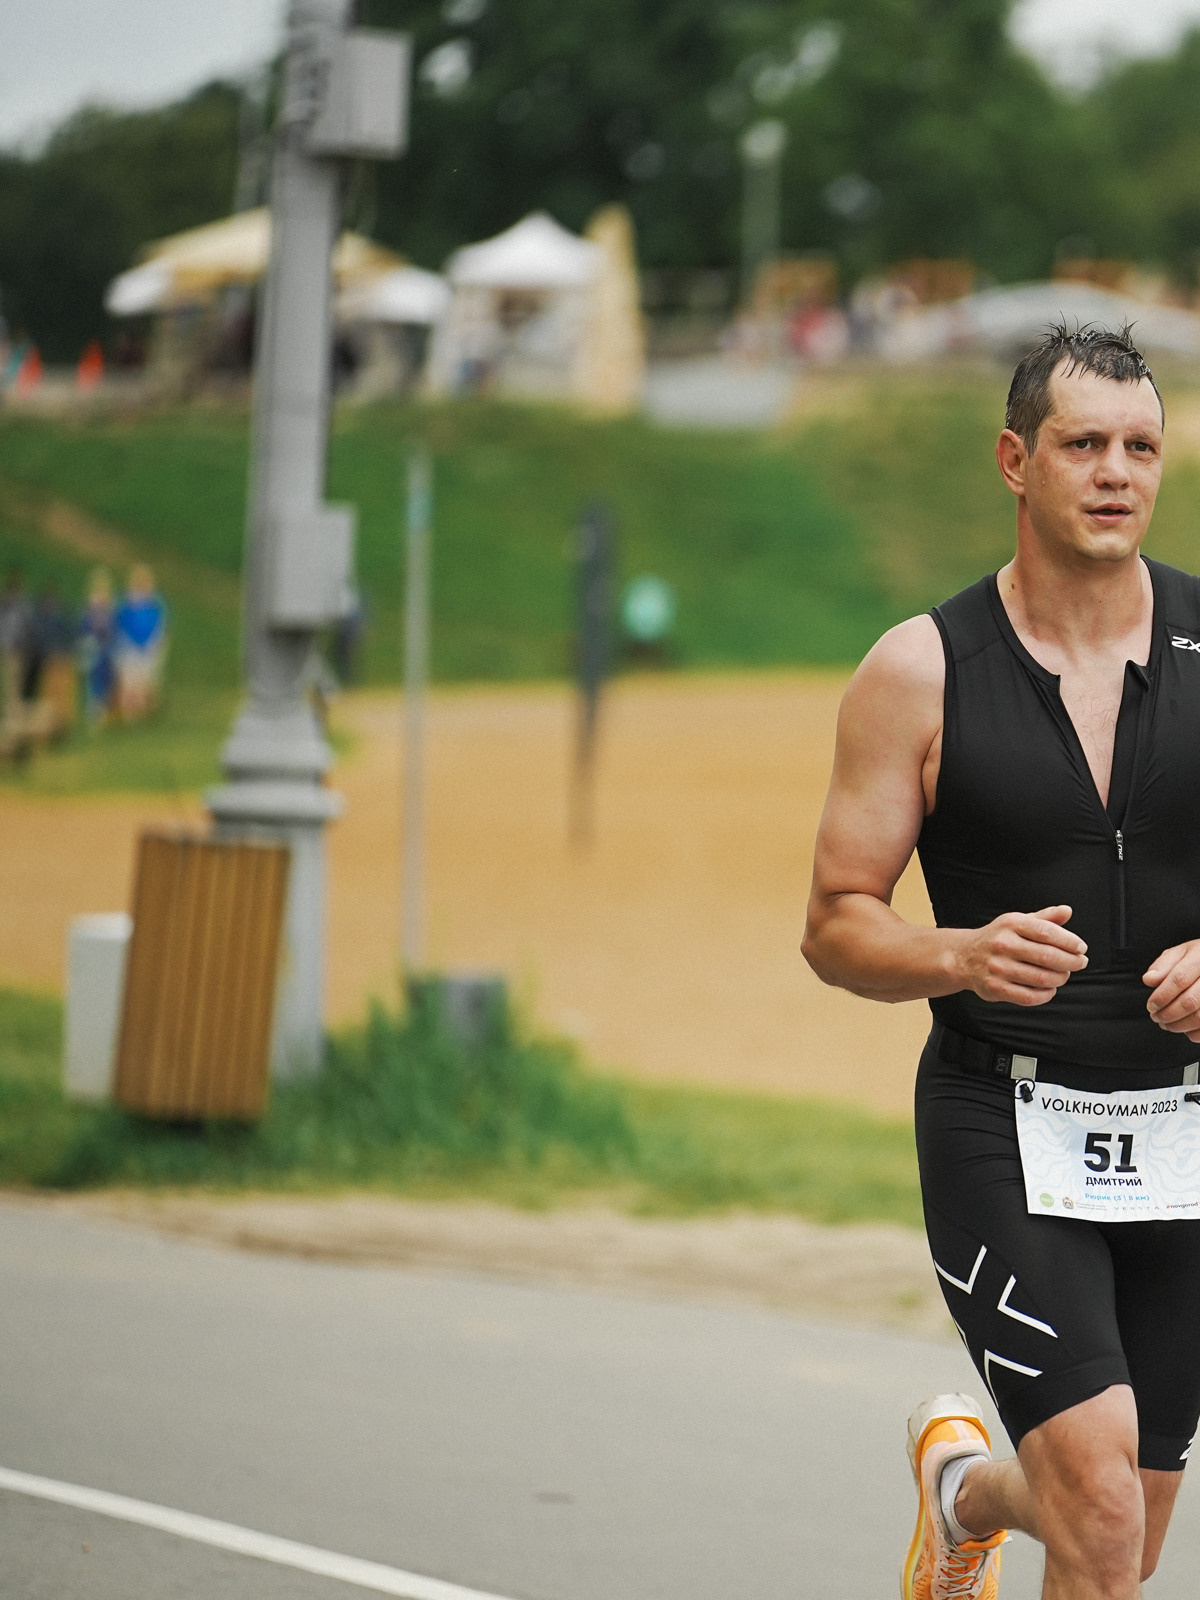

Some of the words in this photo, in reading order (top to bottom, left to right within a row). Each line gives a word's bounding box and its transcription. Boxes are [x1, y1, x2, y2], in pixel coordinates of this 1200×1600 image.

[1041, 1097, 1149, 1117] VOLKHOVMAN
[1150, 1099, 1178, 1115] 2023
[1083, 1132, 1138, 1173] 51
[1085, 1176, 1143, 1187] ДМИТРИЙ
